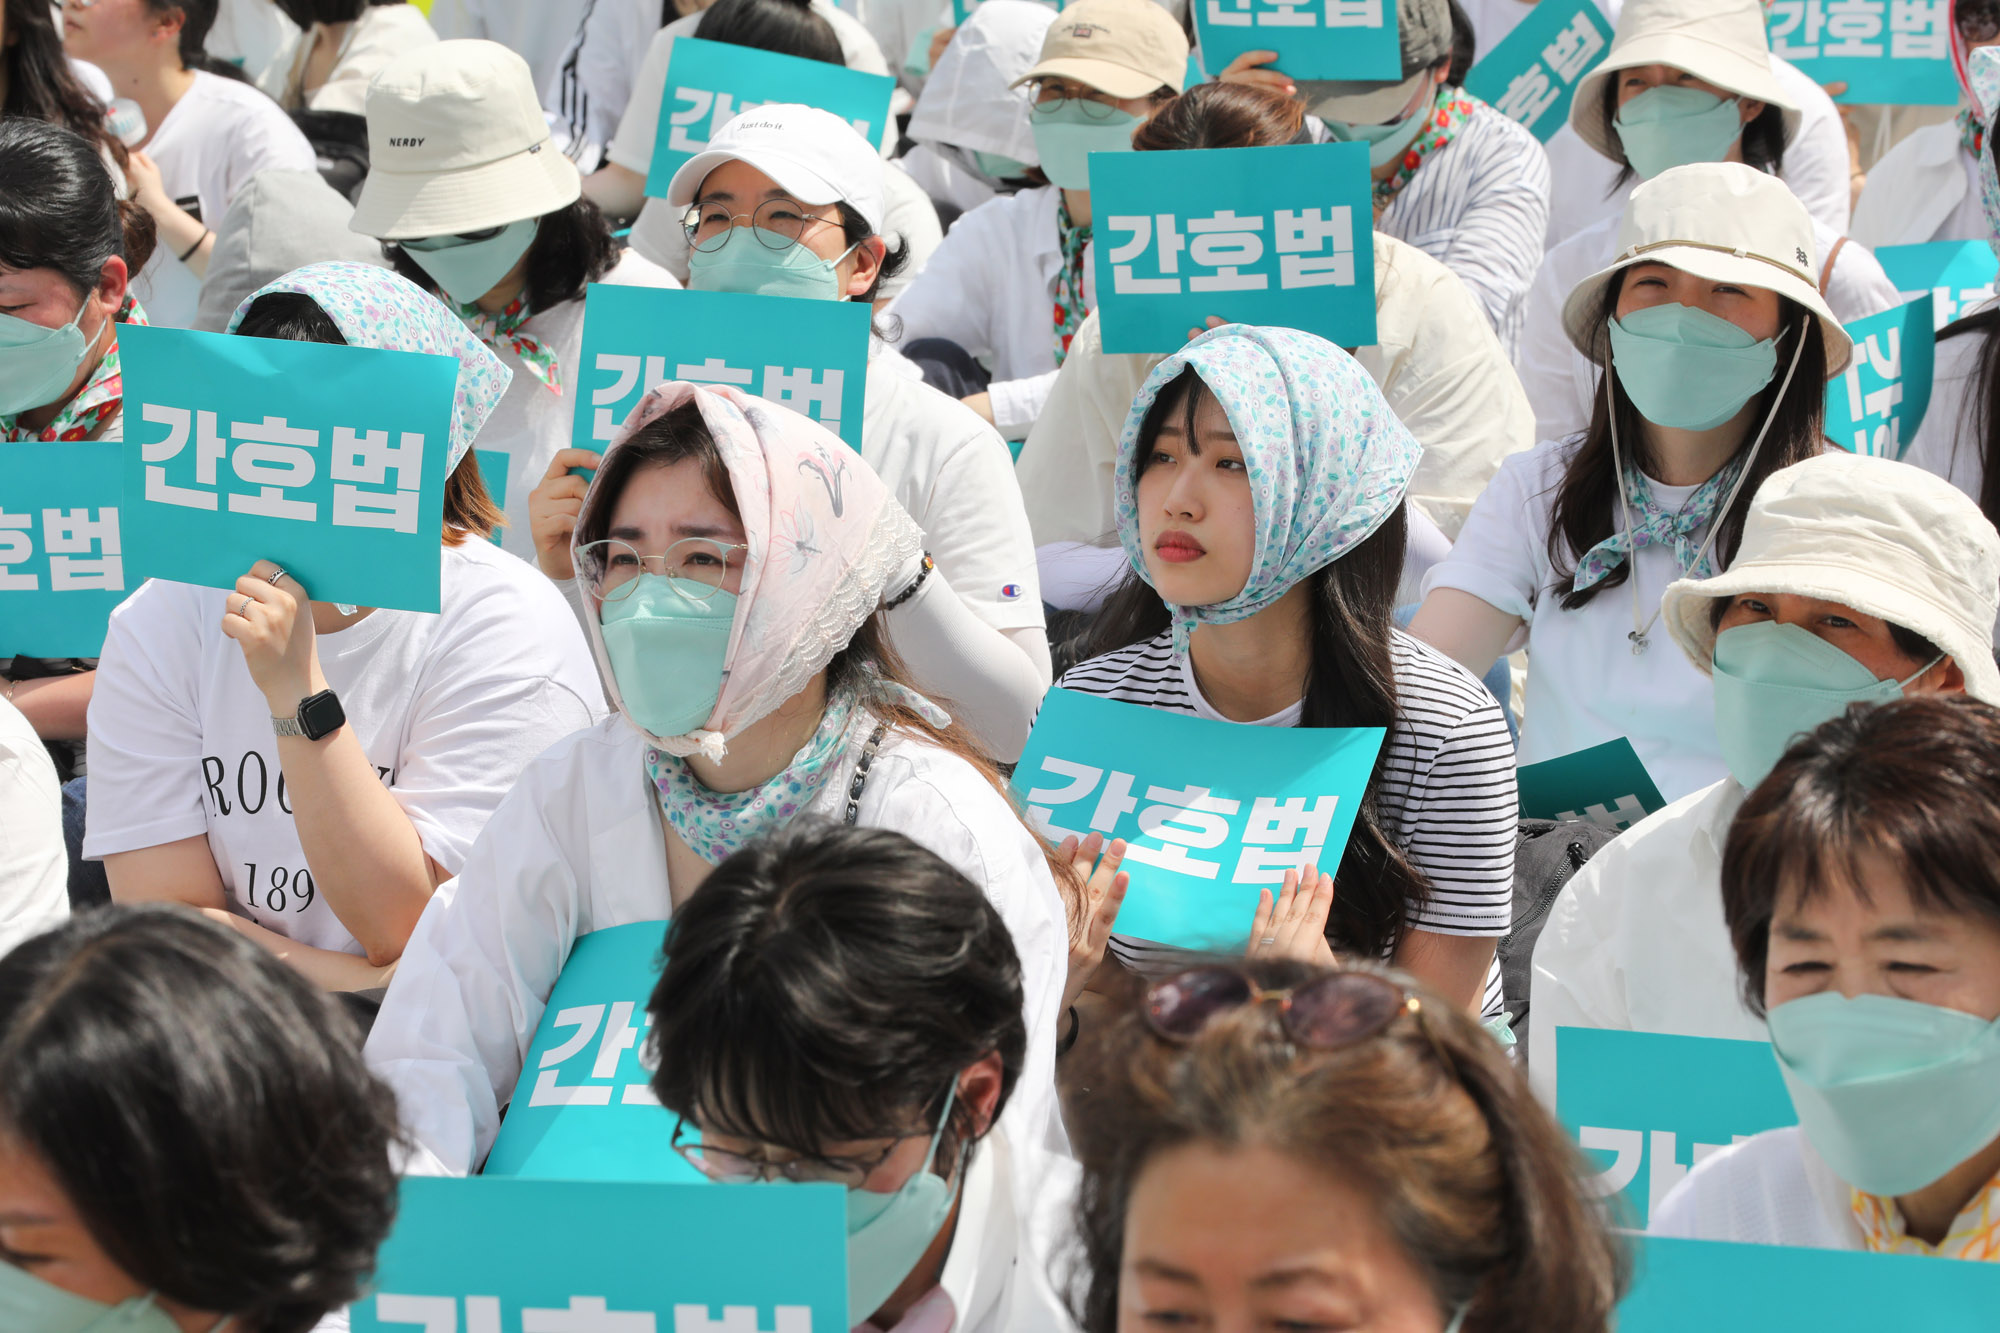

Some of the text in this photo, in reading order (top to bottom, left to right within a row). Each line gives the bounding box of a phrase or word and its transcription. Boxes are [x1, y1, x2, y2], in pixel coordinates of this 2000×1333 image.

[1770, 0, 1949, 60] 간호법
[389, 137, 426, 148] NERDY
[1108, 205, 1356, 295] 간호법
[142, 402, 425, 535] 간호법
[1025, 755, 1340, 885] 간호법
